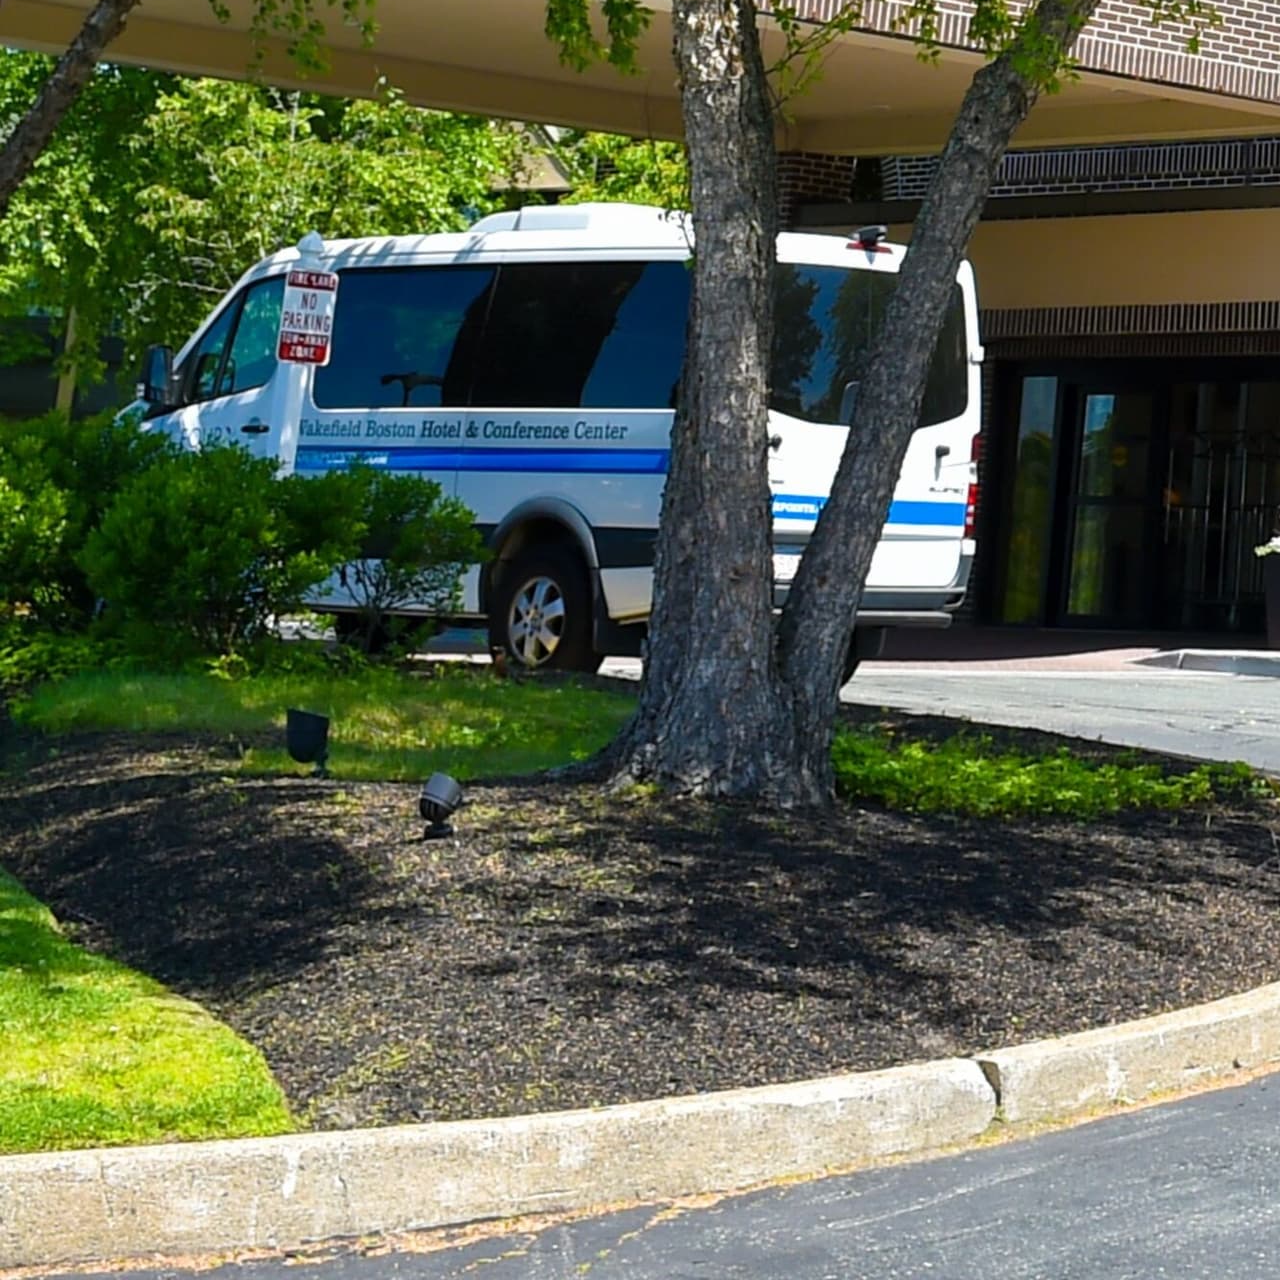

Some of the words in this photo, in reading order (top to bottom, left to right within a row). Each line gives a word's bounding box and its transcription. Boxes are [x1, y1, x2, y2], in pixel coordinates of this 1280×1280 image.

[301, 292, 318, 310] NO
[282, 311, 331, 333] PARKING
[289, 346, 316, 359] ZONE
[365, 420, 416, 438] Boston
[421, 420, 463, 438] Hotel
[465, 421, 478, 438] &
[483, 420, 569, 439] Conference
[574, 421, 628, 440] Center
